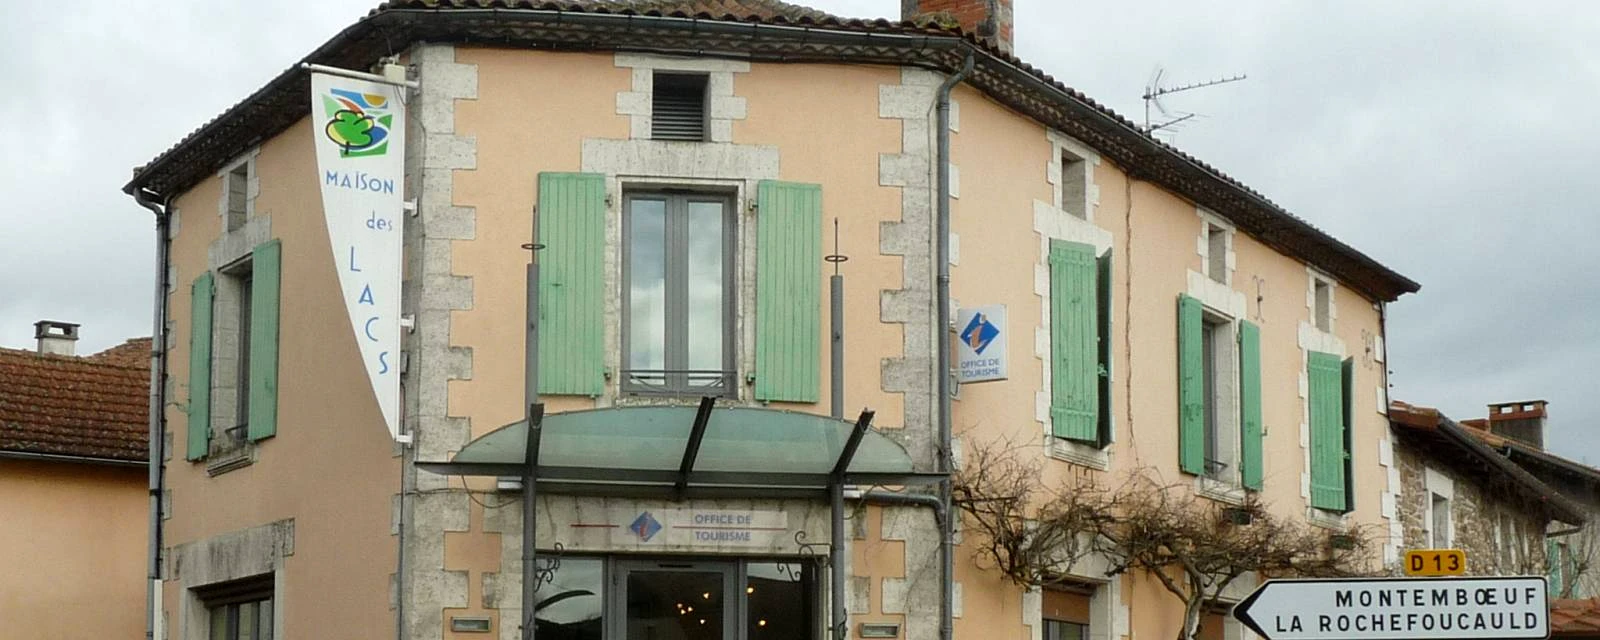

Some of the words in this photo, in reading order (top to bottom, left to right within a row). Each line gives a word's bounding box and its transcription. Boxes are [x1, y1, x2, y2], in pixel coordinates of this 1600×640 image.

[366, 210, 393, 231] des
[961, 360, 987, 369] OFFICE
[988, 358, 1000, 367] DE
[961, 367, 1000, 378] TOURISME
[695, 514, 733, 524] OFFICE
[736, 514, 752, 524] DE
[695, 531, 751, 541] TOURISME
[1411, 555, 1424, 572] D
[1433, 555, 1460, 572] 13
[1276, 615, 1303, 633] LA
[1319, 612, 1538, 633] ROCHEFOUCAULD
